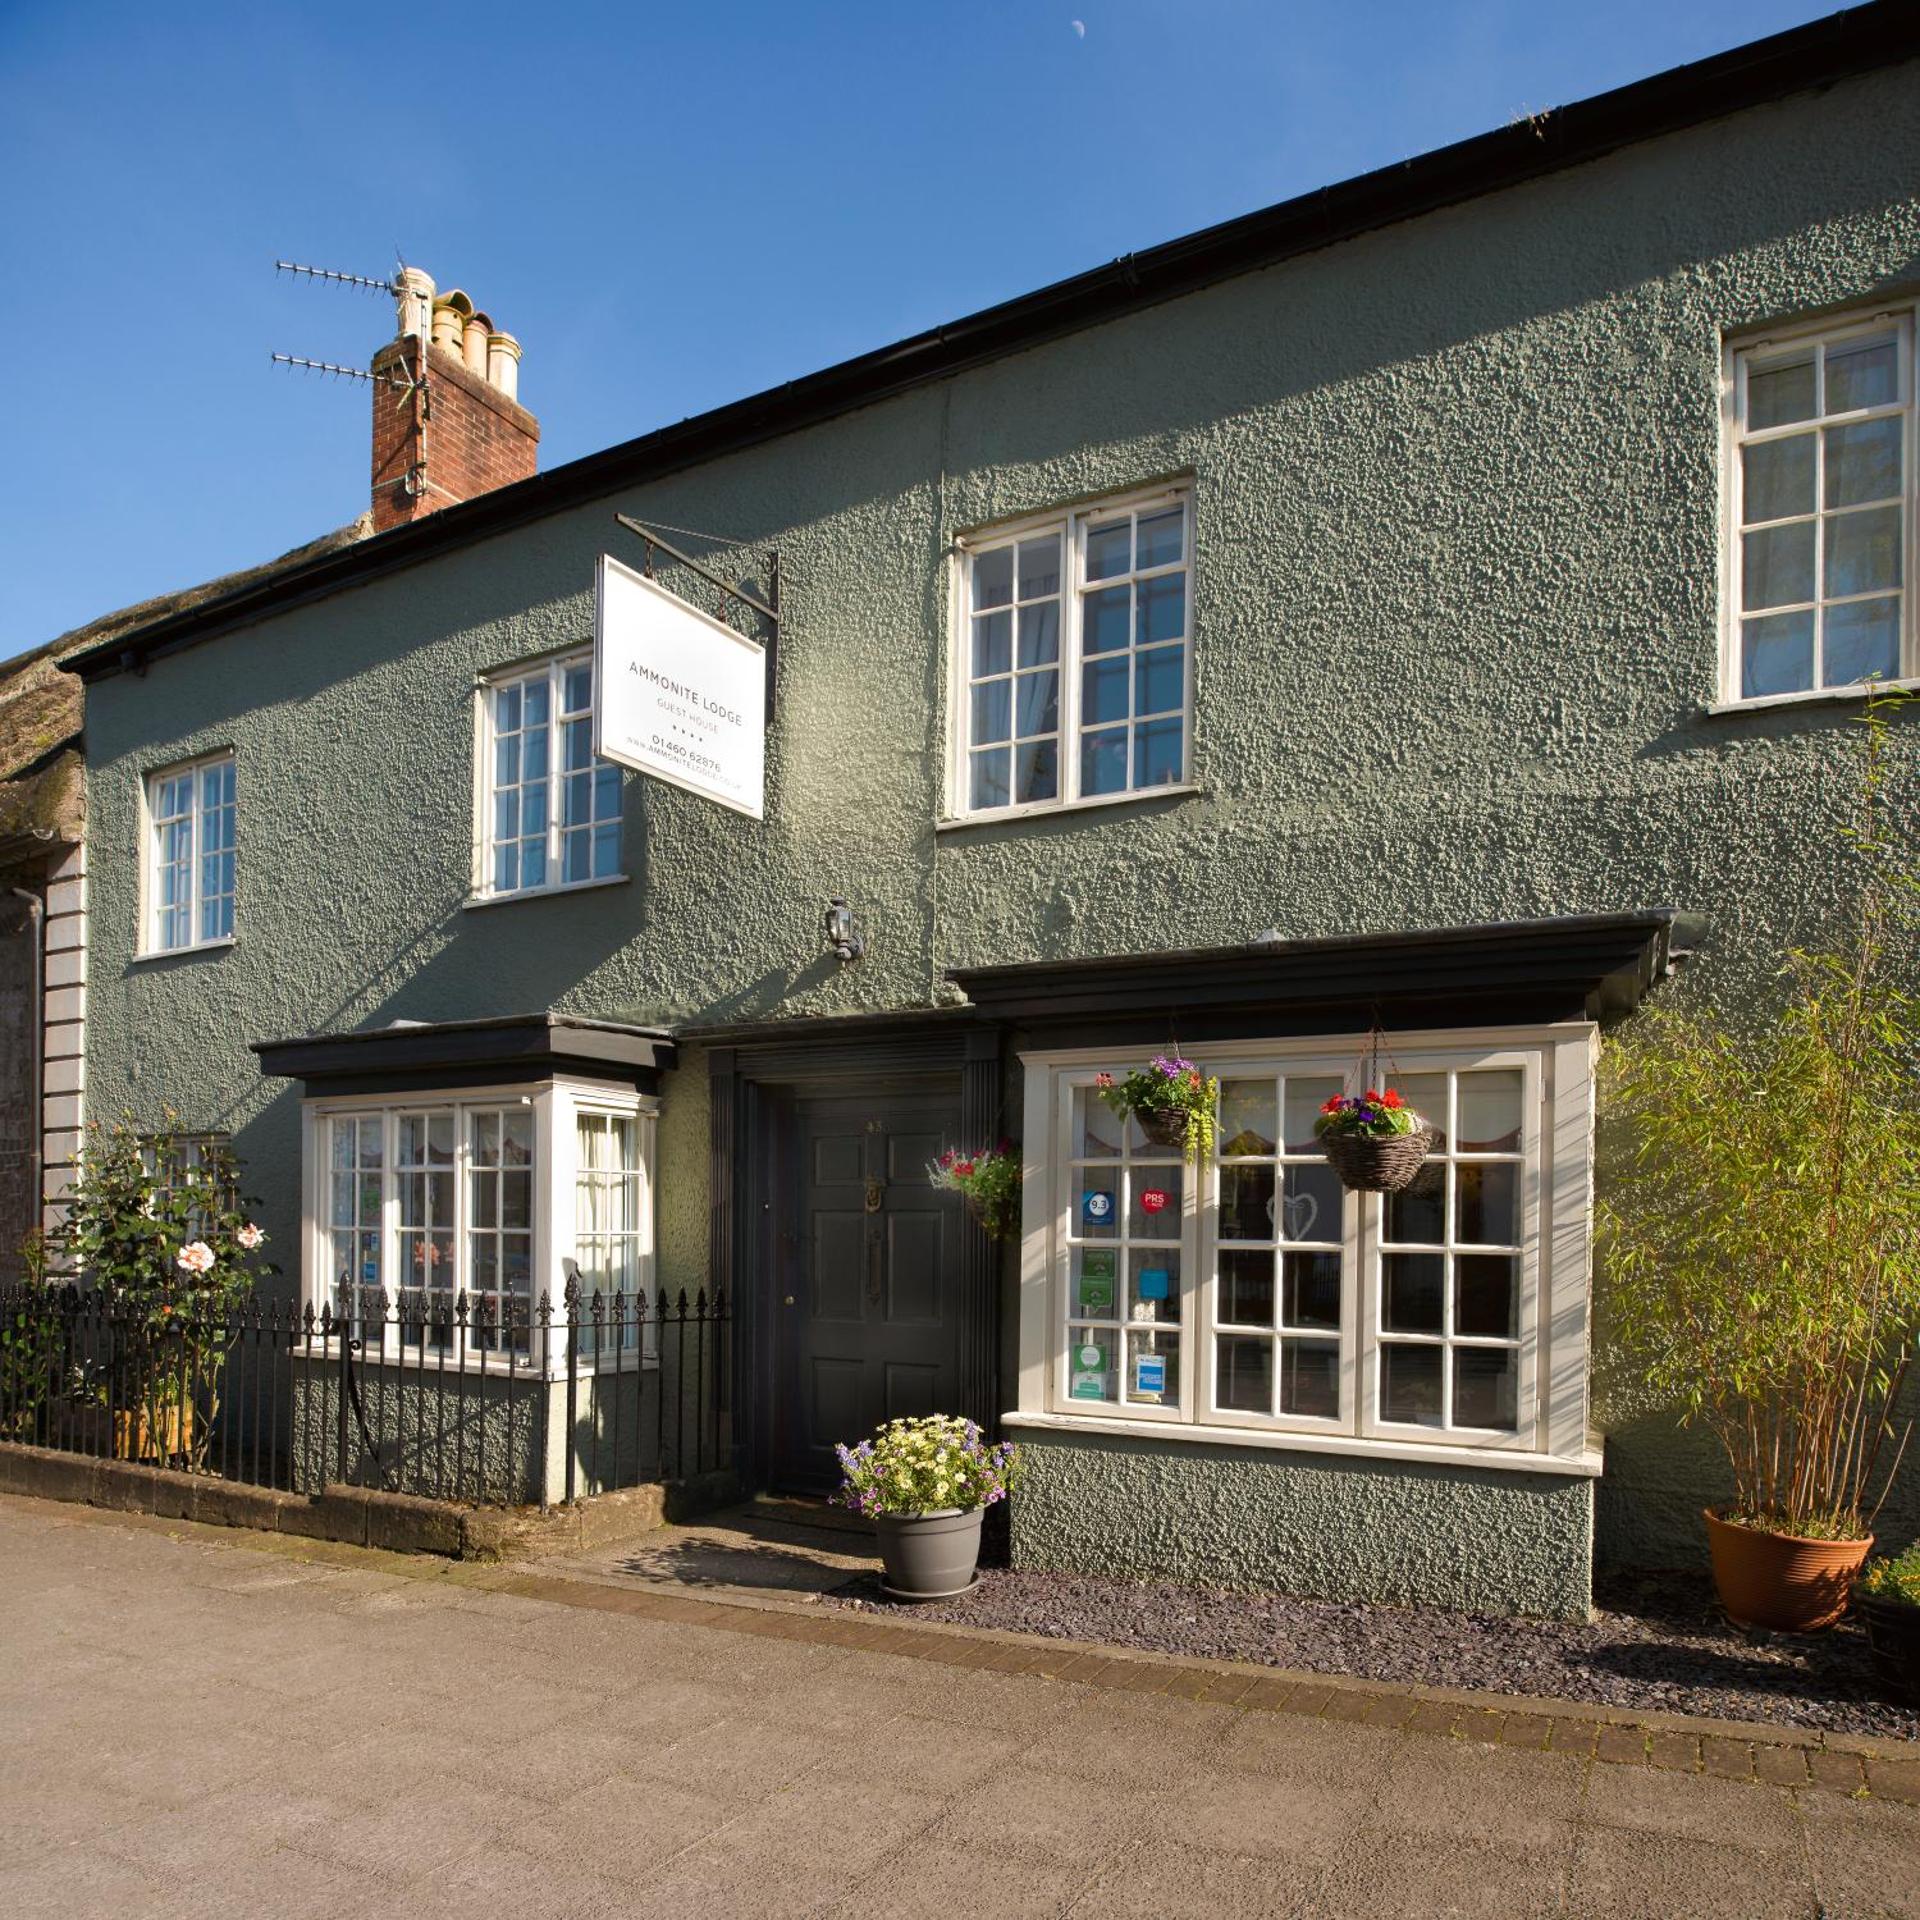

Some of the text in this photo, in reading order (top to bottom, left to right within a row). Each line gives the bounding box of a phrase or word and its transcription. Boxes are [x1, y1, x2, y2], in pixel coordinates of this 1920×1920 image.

[629, 661, 742, 727] AMMONITE LODGE
[656, 698, 719, 735] GUEST HOUSE
[652, 734, 721, 773] 01460 62876
[1091, 1200, 1107, 1209] 9.3
[1145, 1193, 1165, 1203] PRS
